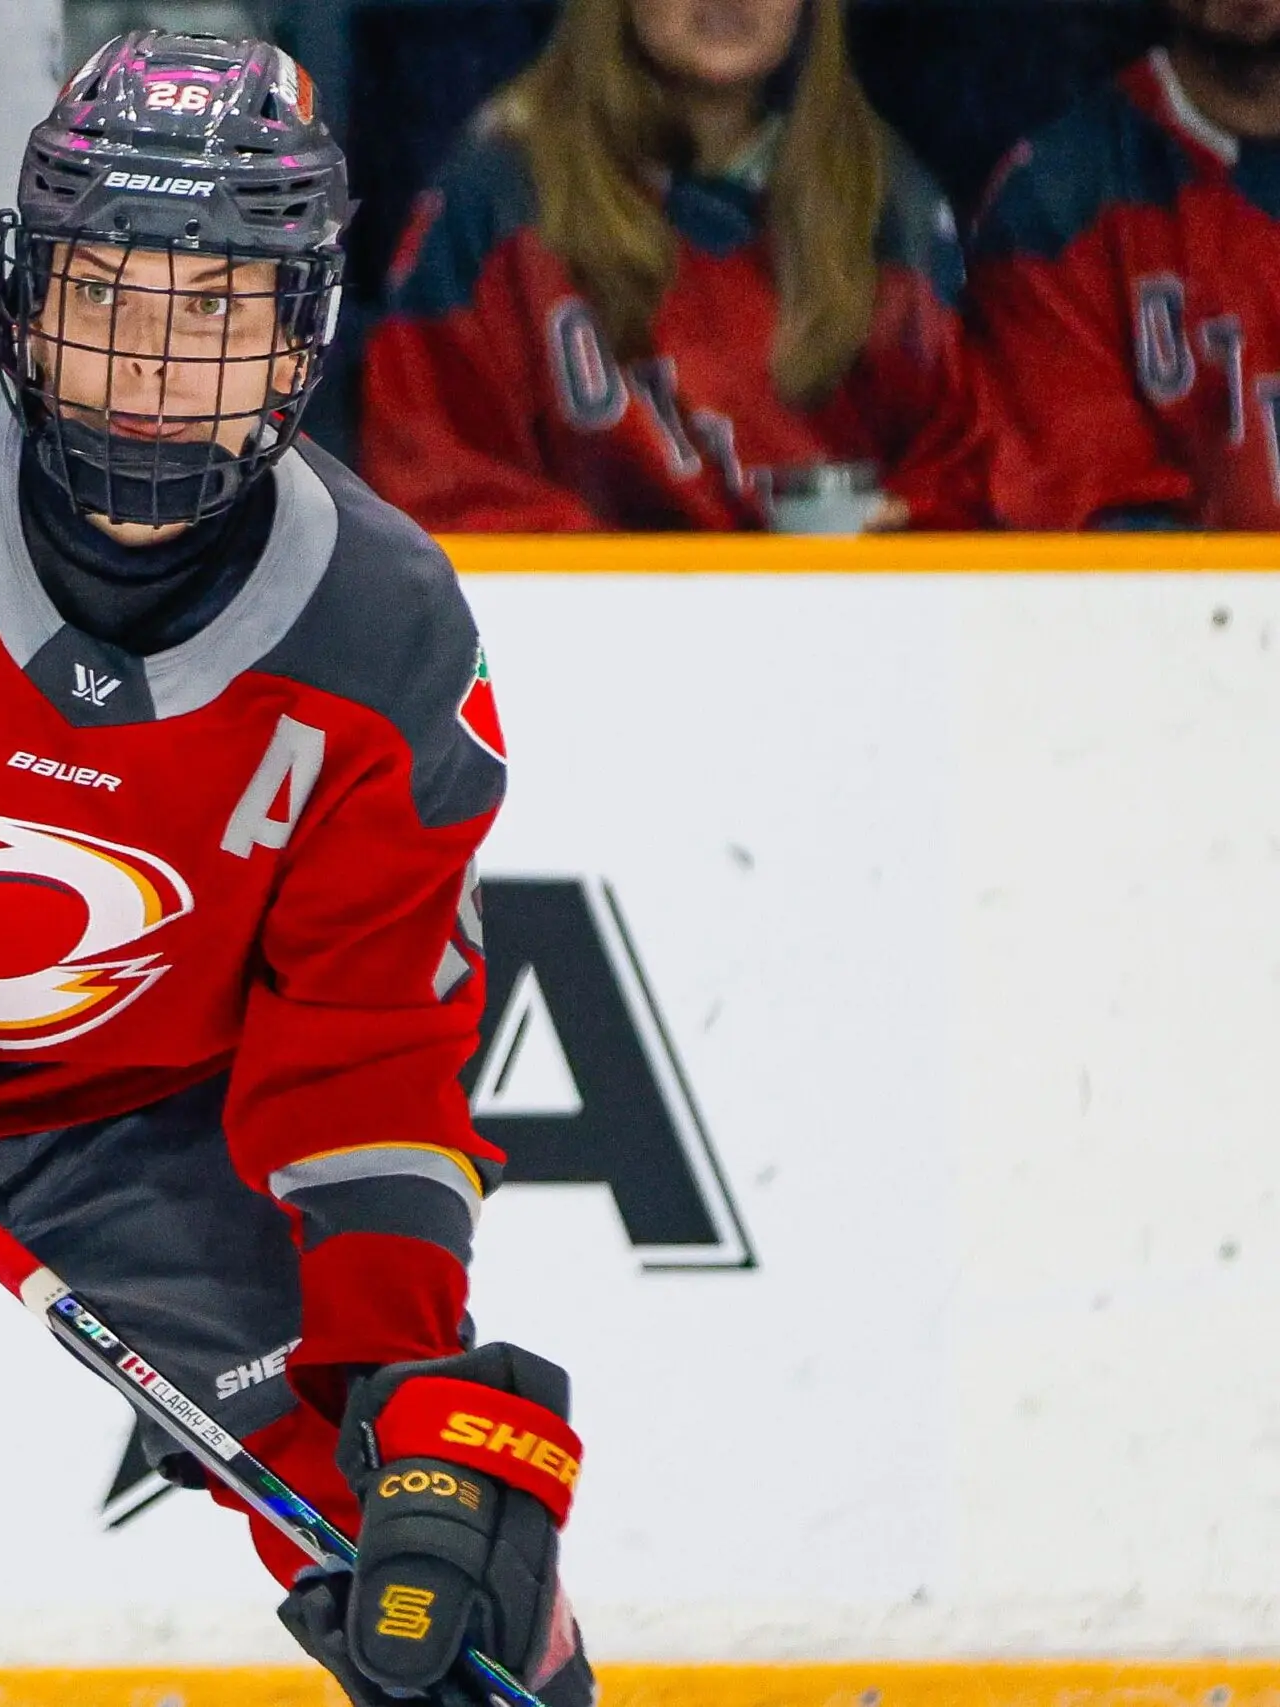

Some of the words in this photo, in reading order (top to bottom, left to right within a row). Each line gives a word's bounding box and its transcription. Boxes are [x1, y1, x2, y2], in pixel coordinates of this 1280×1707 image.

[145, 83, 211, 111] 26
[103, 170, 217, 198] BAUER
[5, 750, 123, 793] BAUER
[220, 713, 326, 858] A
[214, 1336, 303, 1401] SHE
[201, 1424, 227, 1447] 26
[377, 1469, 482, 1512] CODE
